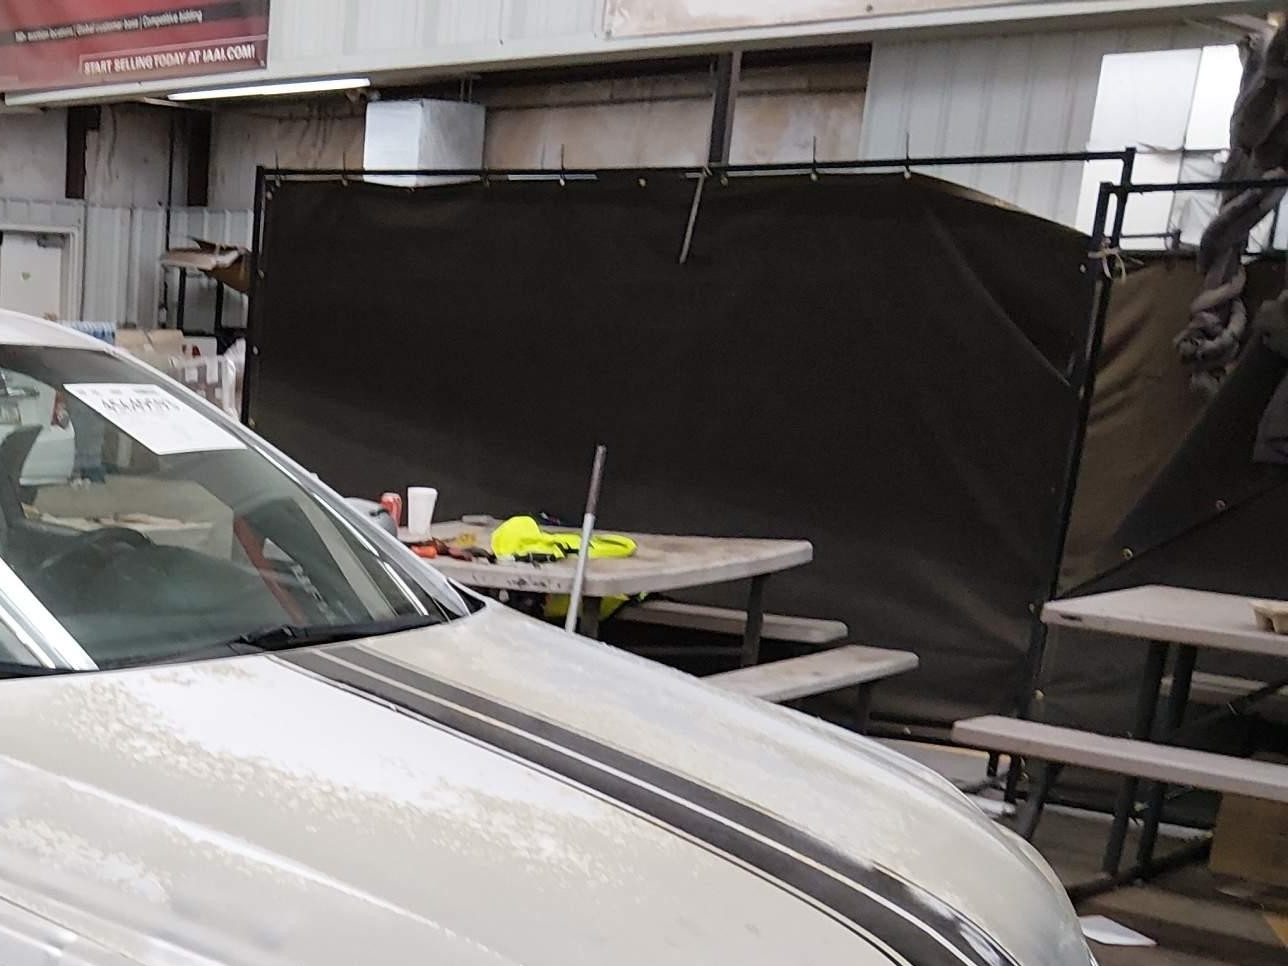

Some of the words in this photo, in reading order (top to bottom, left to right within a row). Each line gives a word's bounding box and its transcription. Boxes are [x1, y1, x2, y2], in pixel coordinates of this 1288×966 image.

[83, 59, 112, 75] START
[114, 54, 153, 73] SELLING
[153, 51, 186, 69] TODAY
[187, 49, 202, 65] AT
